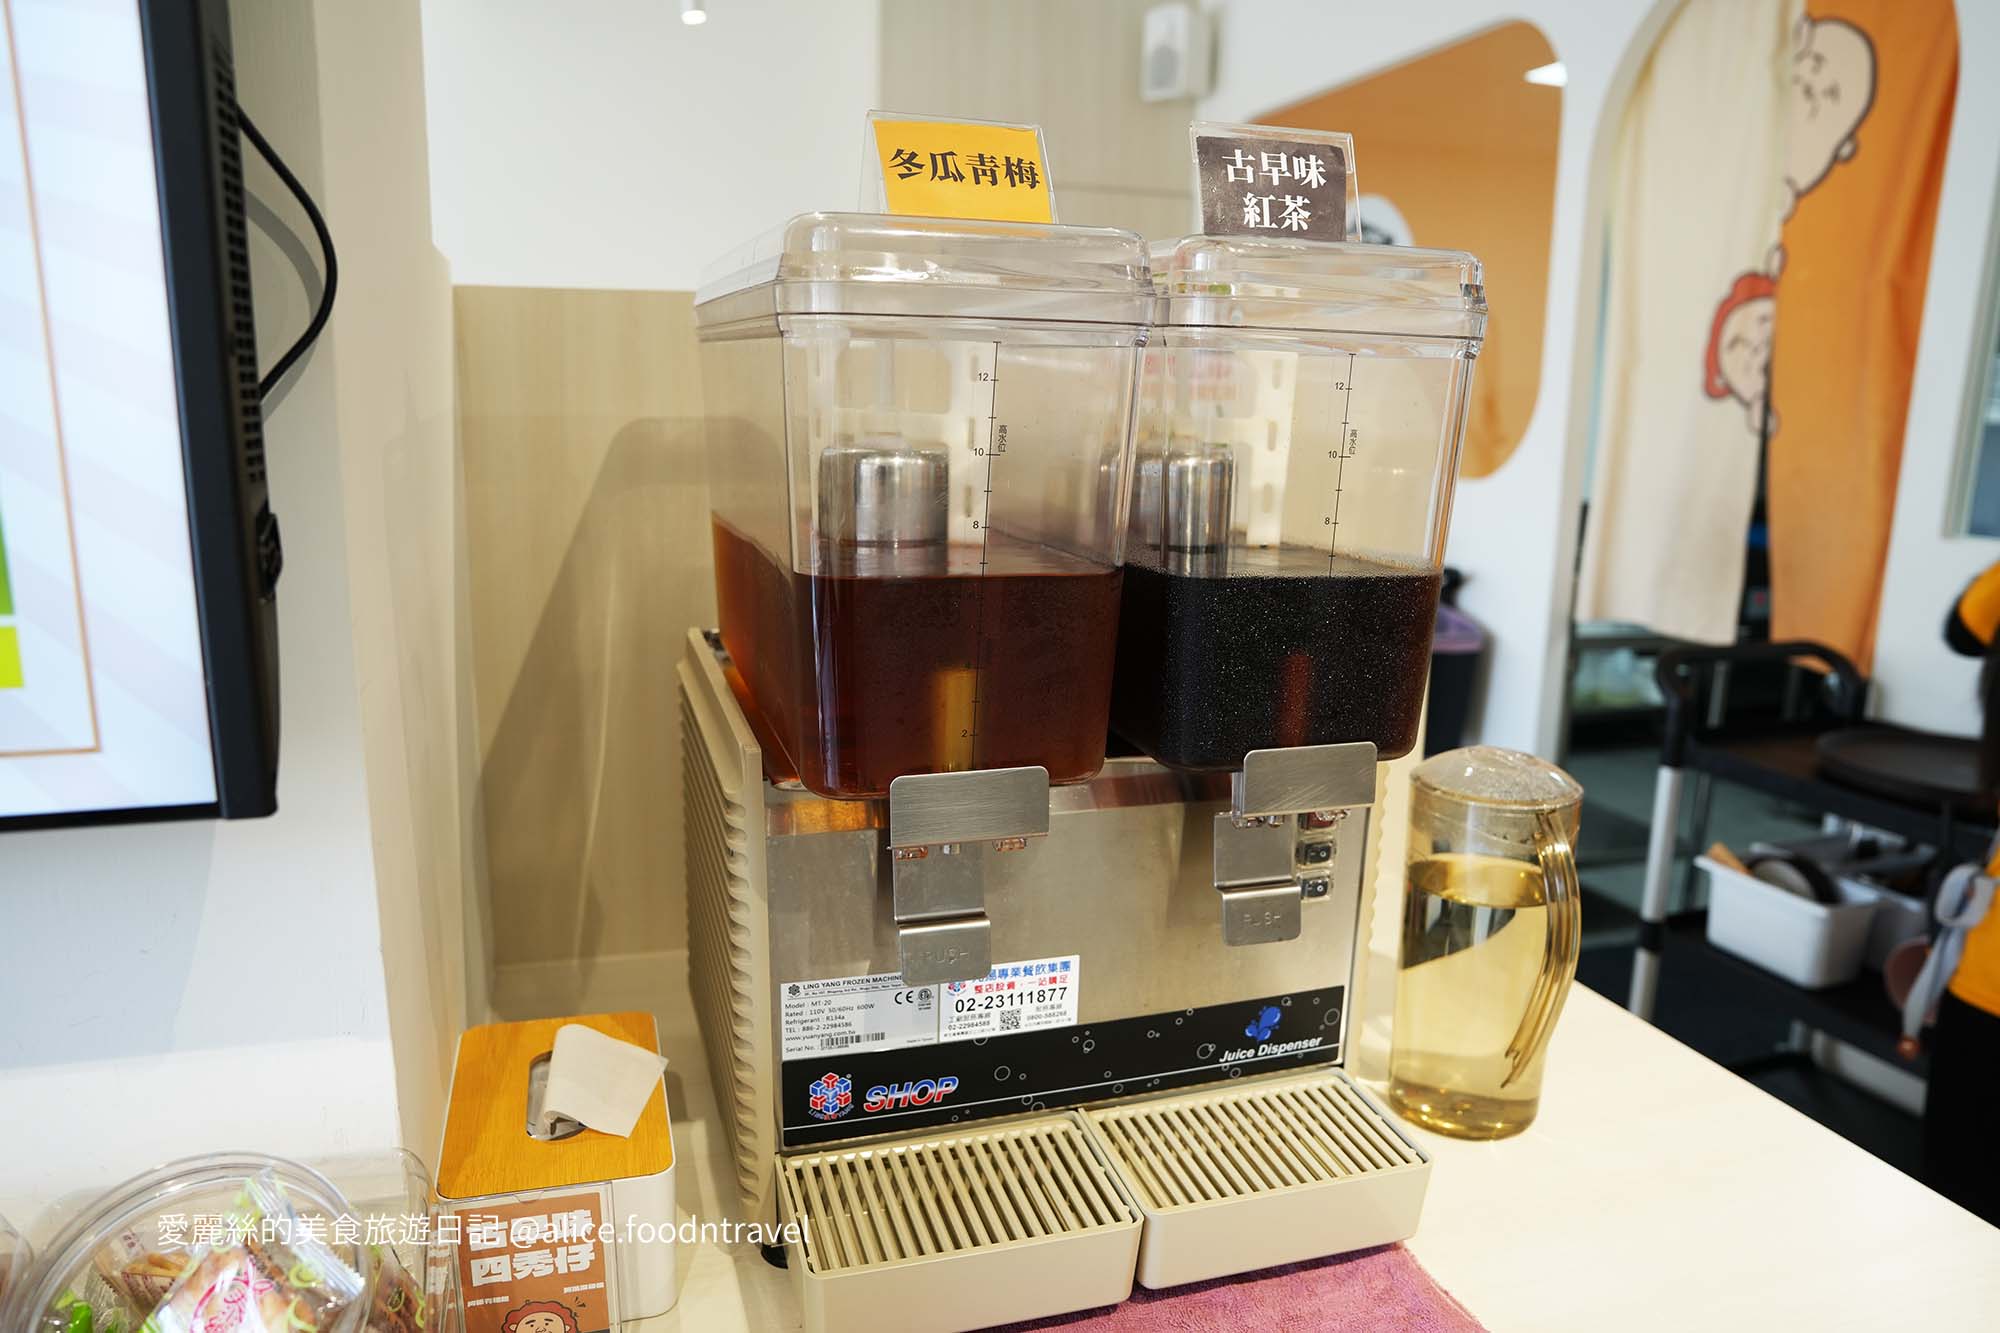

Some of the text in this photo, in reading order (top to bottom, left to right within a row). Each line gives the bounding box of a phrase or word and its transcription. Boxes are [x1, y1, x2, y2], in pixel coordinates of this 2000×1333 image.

[889, 148, 1040, 190] 冬瓜青梅
[1221, 148, 1327, 189] 古早味
[1243, 192, 1312, 232] 紅茶
[978, 373, 989, 381] 12
[1335, 382, 1344, 391] 12
[974, 448, 984, 456] 10
[1328, 451, 1337, 459] 10
[972, 521, 979, 529] 8
[1324, 517, 1330, 525] 8
[961, 729, 968, 737] 2
[803, 982, 820, 990] LING
[821, 980, 841, 988] YANG
[894, 990, 914, 1005] CE
[955, 987, 1067, 1013] 02-23111877
[1219, 1036, 1323, 1062] Juice Dispenser
[864, 1076, 959, 1112] SHOP
[470, 1242, 595, 1287] 四秀仔
